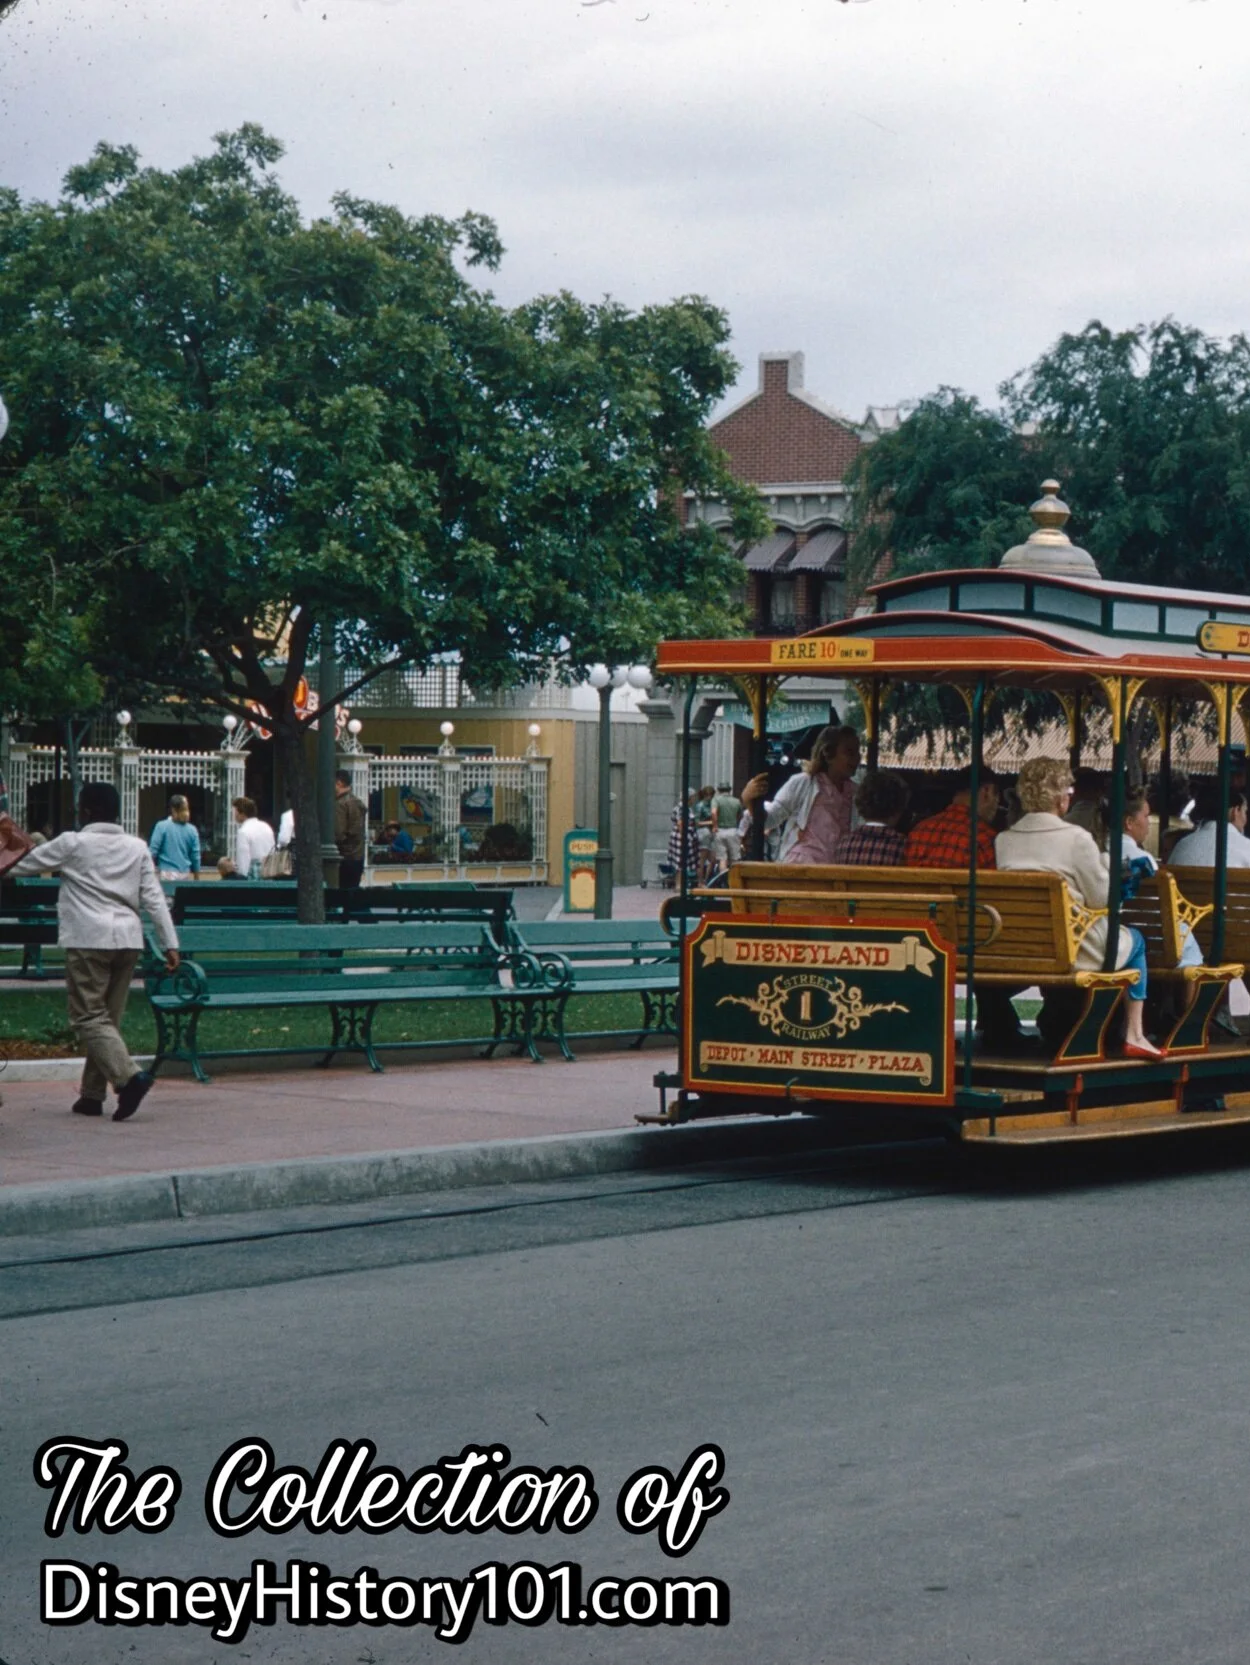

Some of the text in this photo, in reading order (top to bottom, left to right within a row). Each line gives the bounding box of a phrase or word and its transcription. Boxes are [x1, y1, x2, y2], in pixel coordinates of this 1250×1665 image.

[779, 642, 816, 659] FARE
[840, 650, 852, 658] ONE
[855, 649, 868, 658] WAY
[735, 942, 890, 966] DISNEYLAND
[783, 974, 834, 990] STREET
[800, 990, 812, 1021] 1
[781, 1022, 832, 1040] RAILWAY
[706, 1045, 925, 1073] DEPOT MAIN STREET PLAZA
